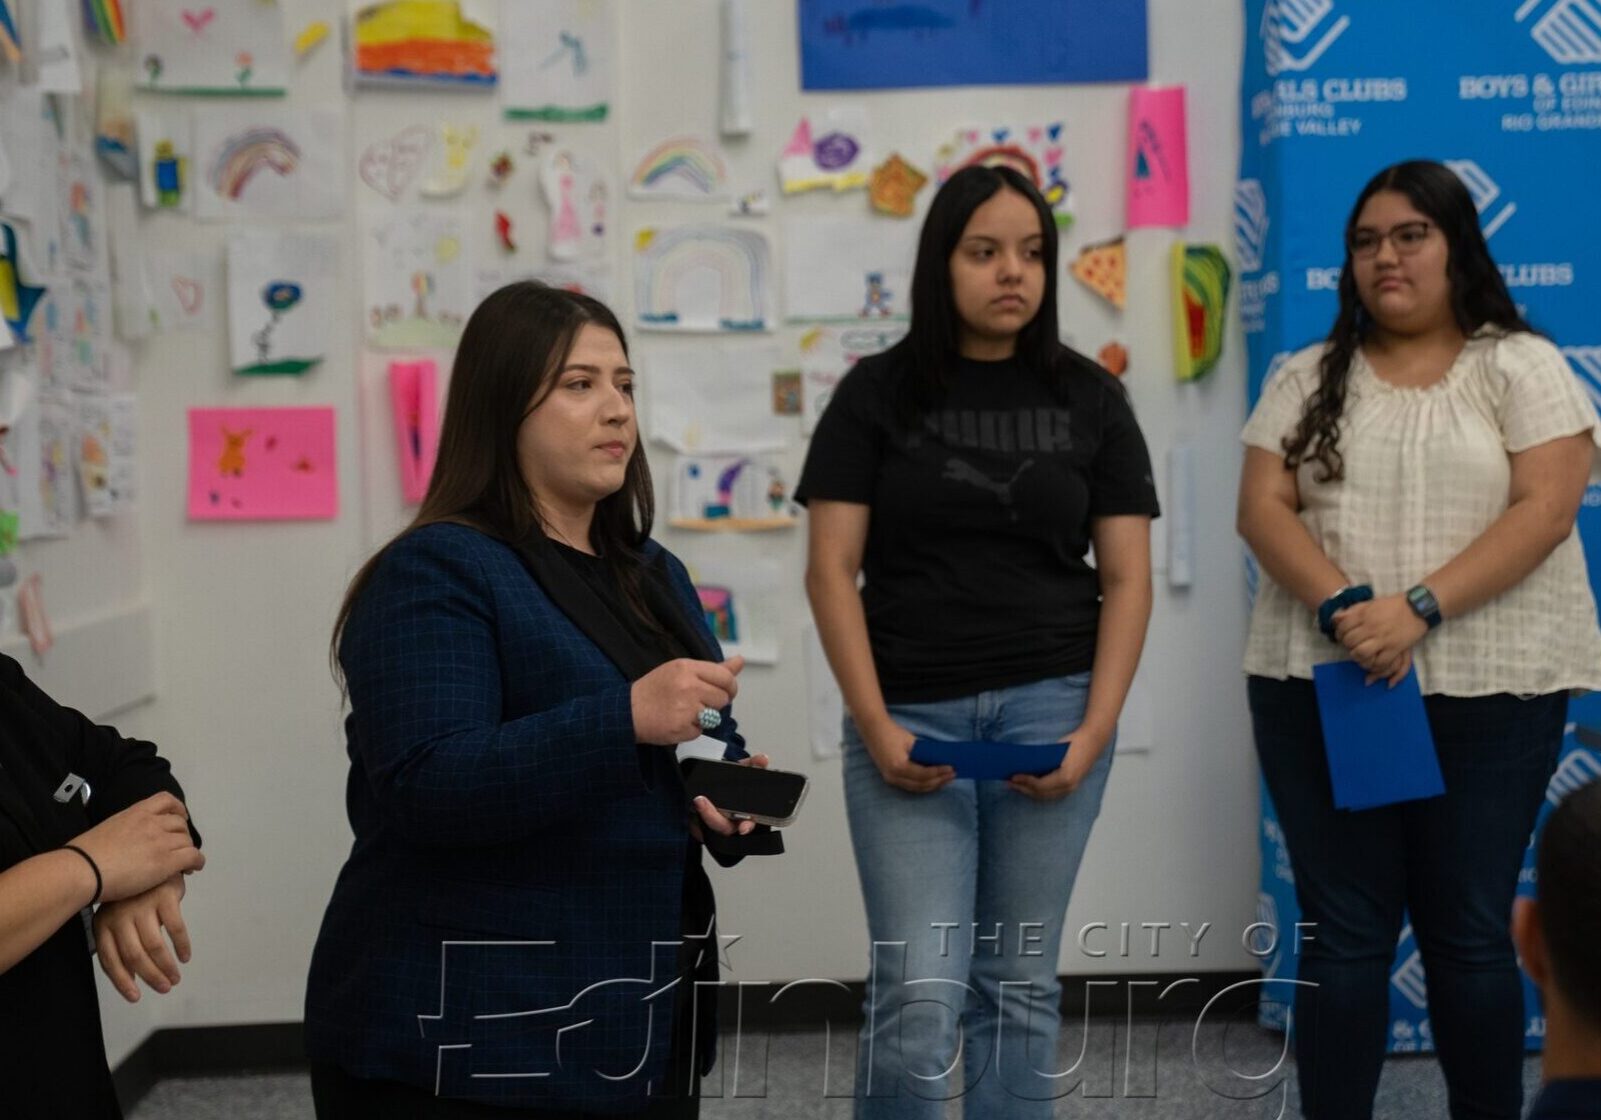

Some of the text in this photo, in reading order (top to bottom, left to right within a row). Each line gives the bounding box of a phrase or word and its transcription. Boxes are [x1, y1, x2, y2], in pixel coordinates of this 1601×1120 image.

[1323, 77, 1408, 102] CLUBS
[1459, 72, 1601, 99] BOYS & GIR
[1295, 117, 1362, 136] VALLEY
[1501, 113, 1534, 131] RIO
